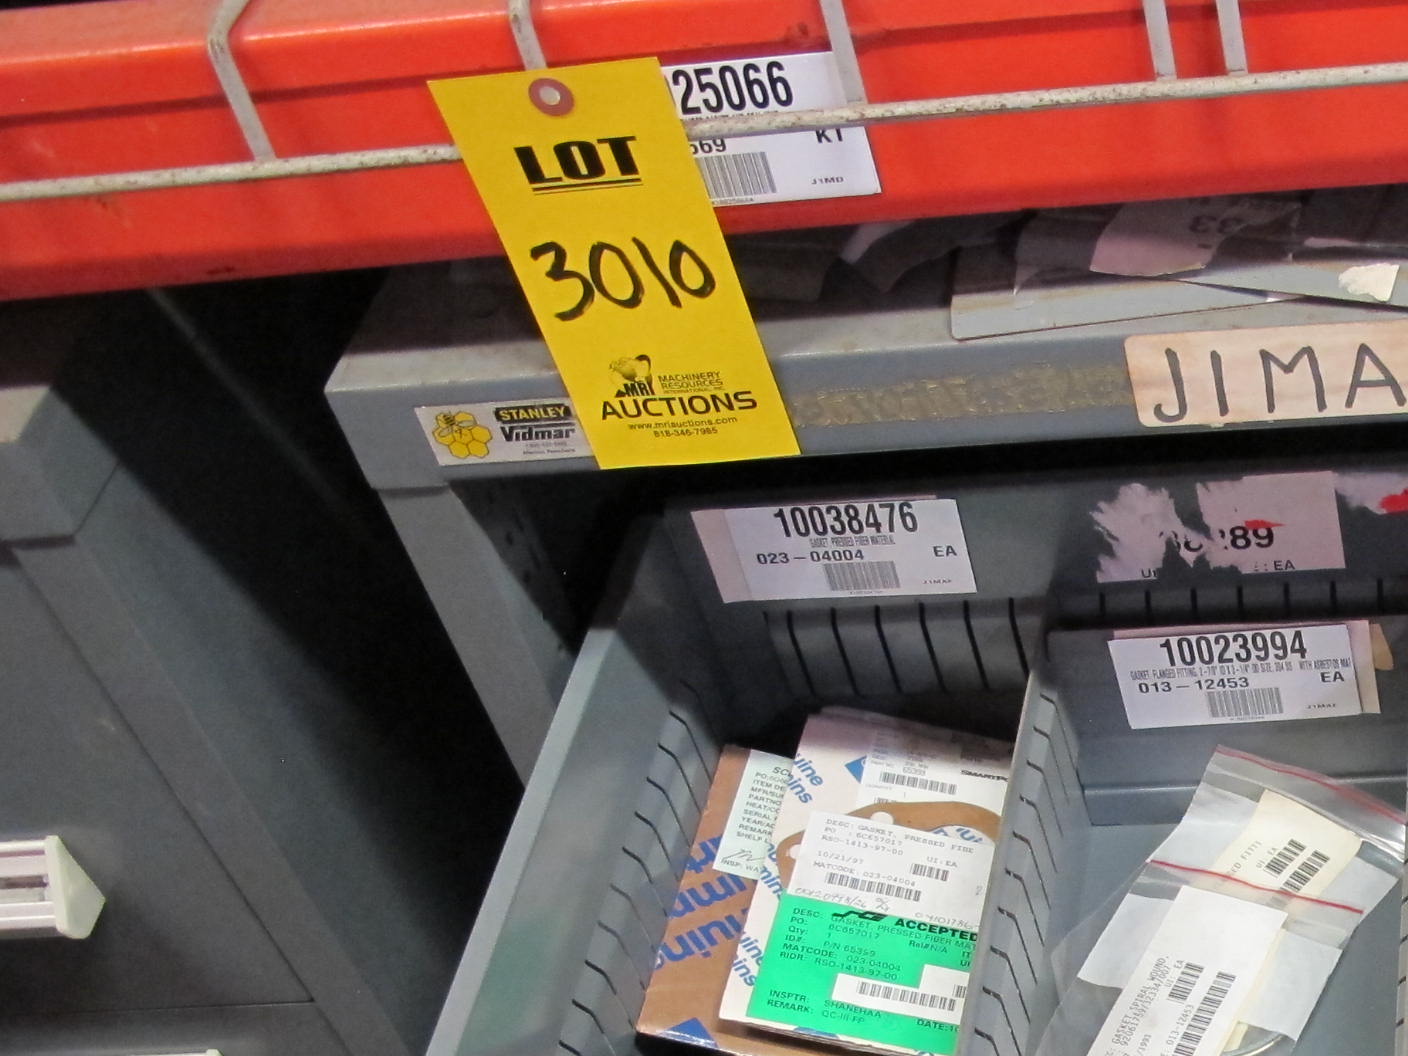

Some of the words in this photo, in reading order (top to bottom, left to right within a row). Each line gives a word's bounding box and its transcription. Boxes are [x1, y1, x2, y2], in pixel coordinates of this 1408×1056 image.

[513, 136, 640, 185] LOT
[530, 236, 717, 322] 3010
[658, 371, 721, 383] MACHINERY
[661, 379, 724, 390] RESOURCES
[1153, 343, 1407, 423] JIMA
[499, 406, 566, 421] STANLEY
[601, 390, 758, 421] AUCTIONS
[500, 425, 576, 442] Vidmar
[774, 501, 918, 538] 10038476
[933, 545, 958, 558] EA
[1160, 631, 1307, 667] 10023994
[1320, 672, 1345, 683] EA
[895, 917, 977, 942] ACCEPTED
